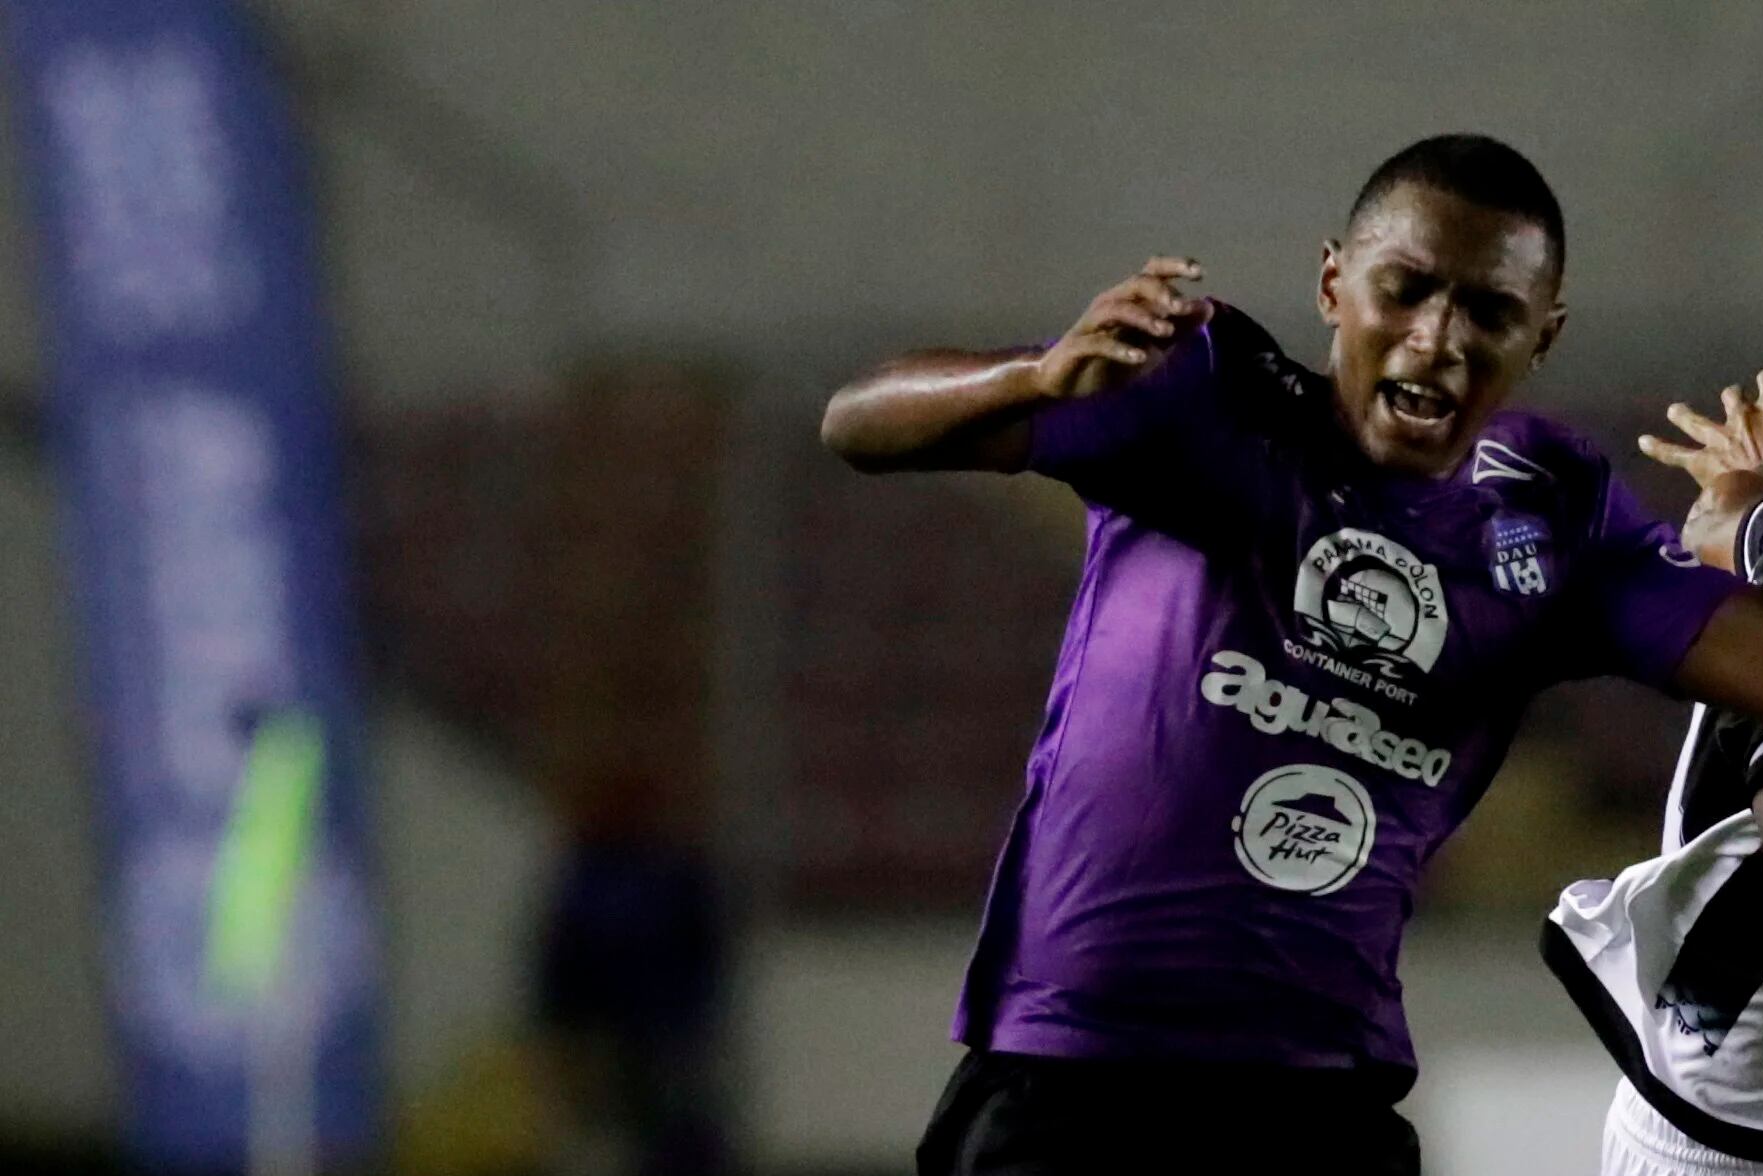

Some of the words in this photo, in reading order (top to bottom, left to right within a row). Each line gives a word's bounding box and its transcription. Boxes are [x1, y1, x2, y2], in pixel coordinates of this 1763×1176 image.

[1395, 557, 1439, 620] COLON
[1283, 638, 1373, 689] CONTAINER
[1374, 678, 1419, 707] PORT
[1201, 650, 1452, 787] aguaseo
[1259, 811, 1341, 843] Pizza
[1268, 838, 1334, 864] Hut
